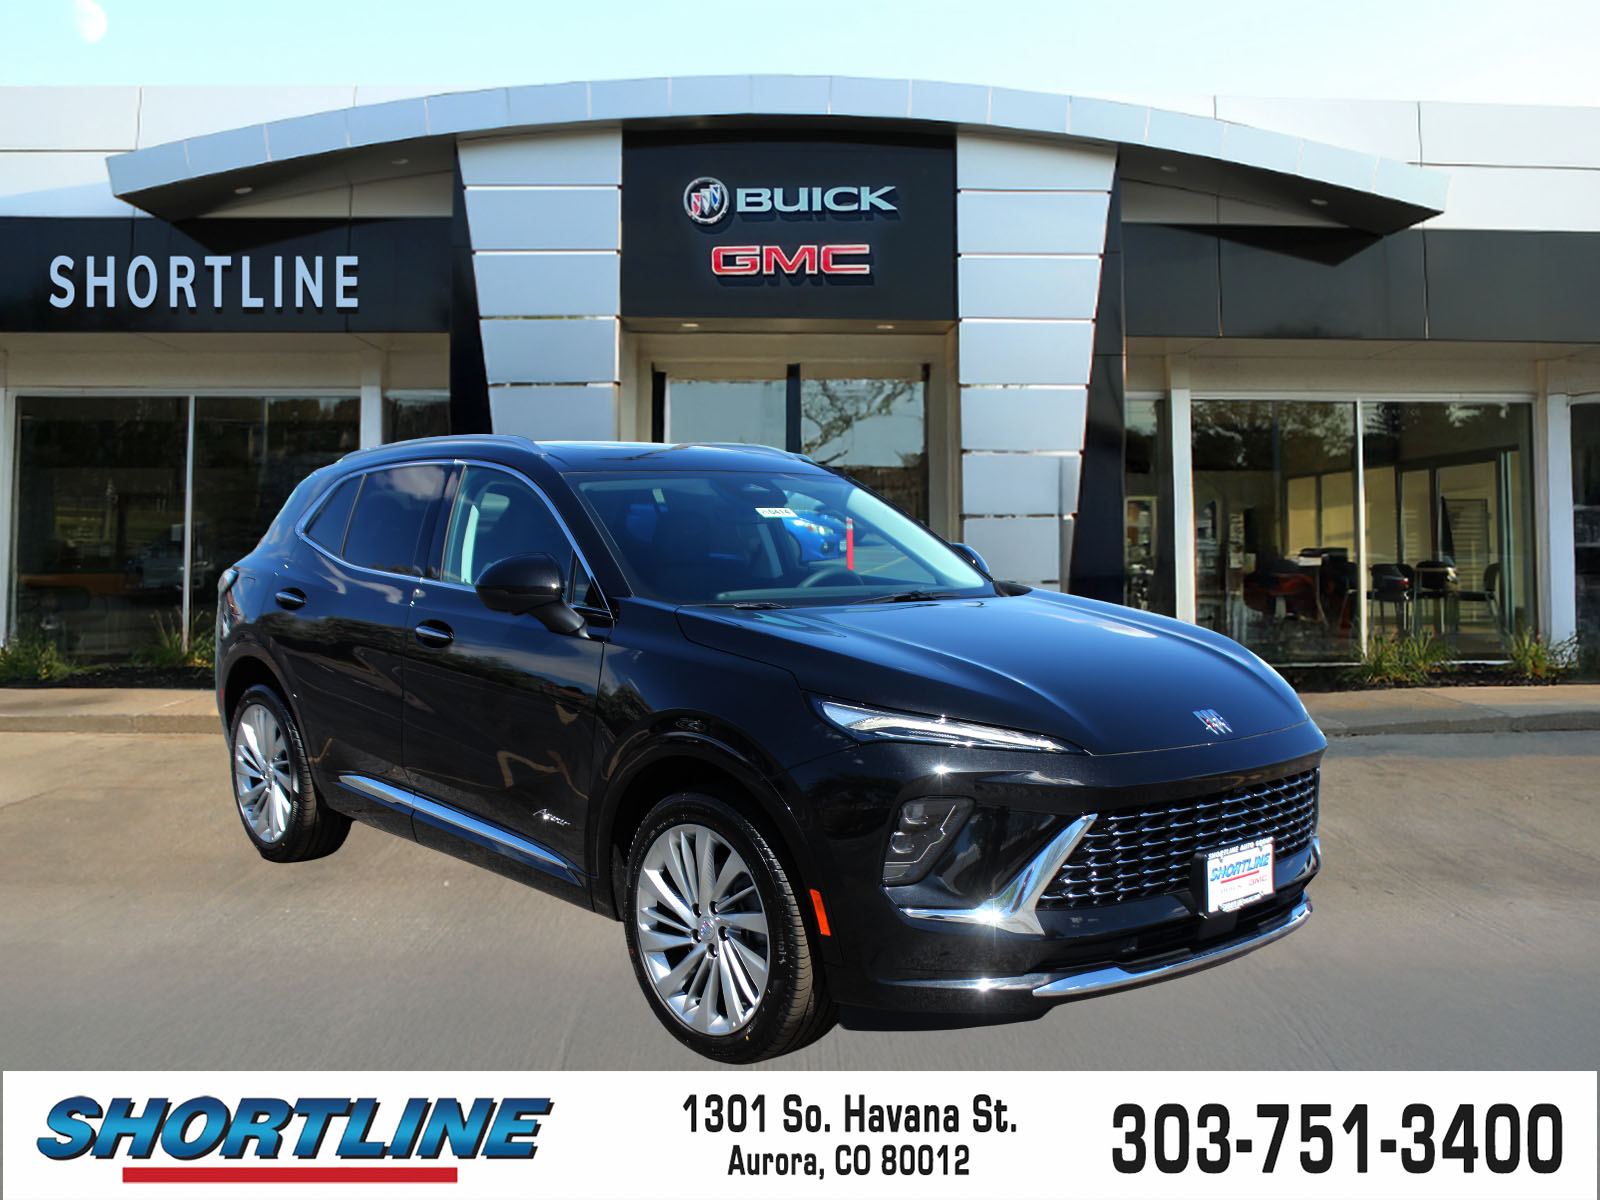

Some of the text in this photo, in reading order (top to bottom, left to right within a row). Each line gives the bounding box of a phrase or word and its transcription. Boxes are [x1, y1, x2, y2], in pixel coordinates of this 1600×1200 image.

[736, 186, 898, 213] BUICK
[711, 244, 870, 275] GMC
[49, 255, 359, 309] SHORTLINE
[1209, 852, 1271, 882] SHORTLINE
